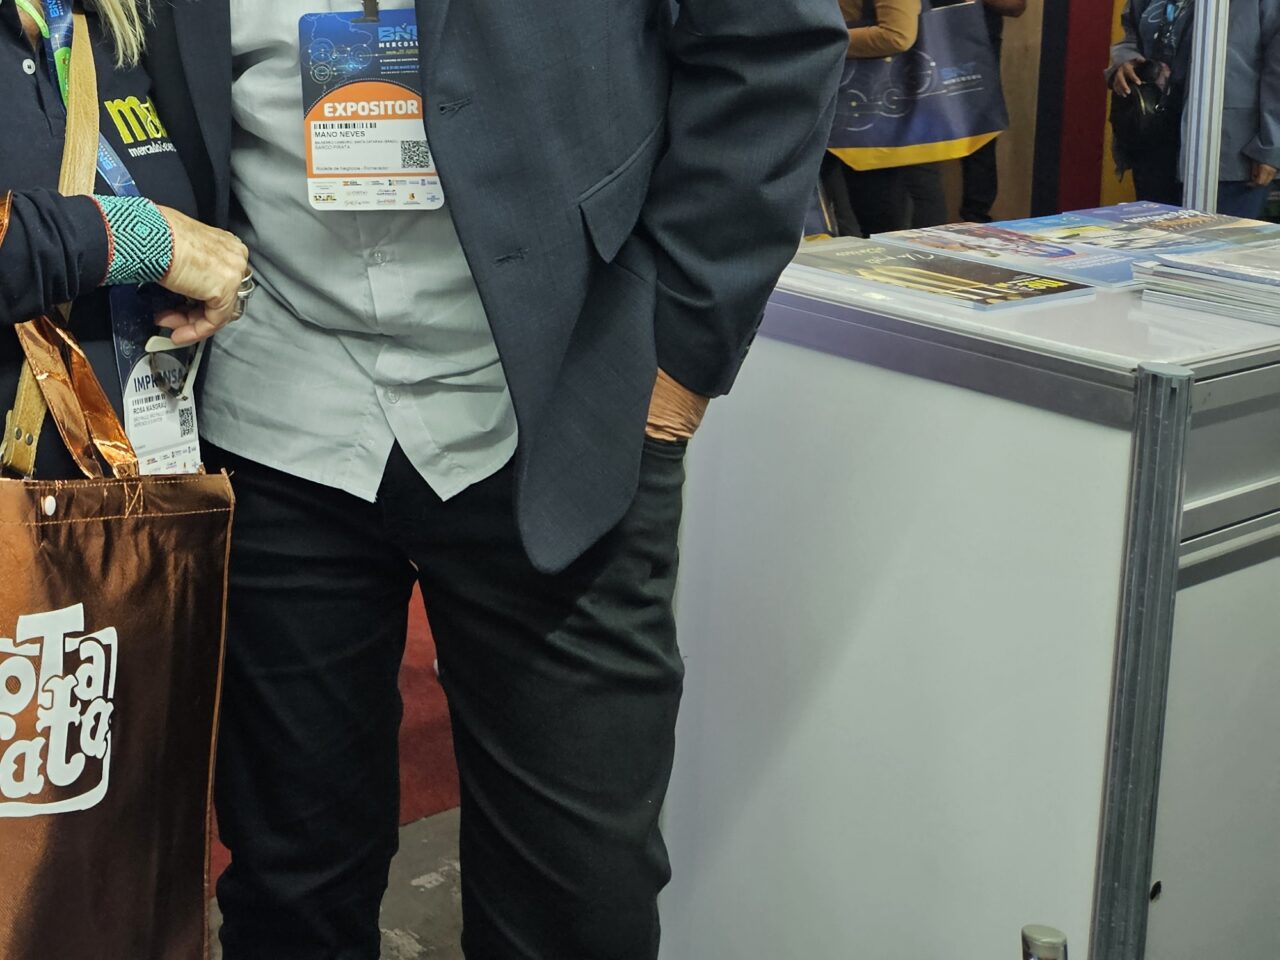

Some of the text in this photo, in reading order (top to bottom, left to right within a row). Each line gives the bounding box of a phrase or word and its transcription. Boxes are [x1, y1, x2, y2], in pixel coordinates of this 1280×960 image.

[323, 100, 419, 118] EXPOSITOR
[314, 130, 366, 139] MANO NEVES
